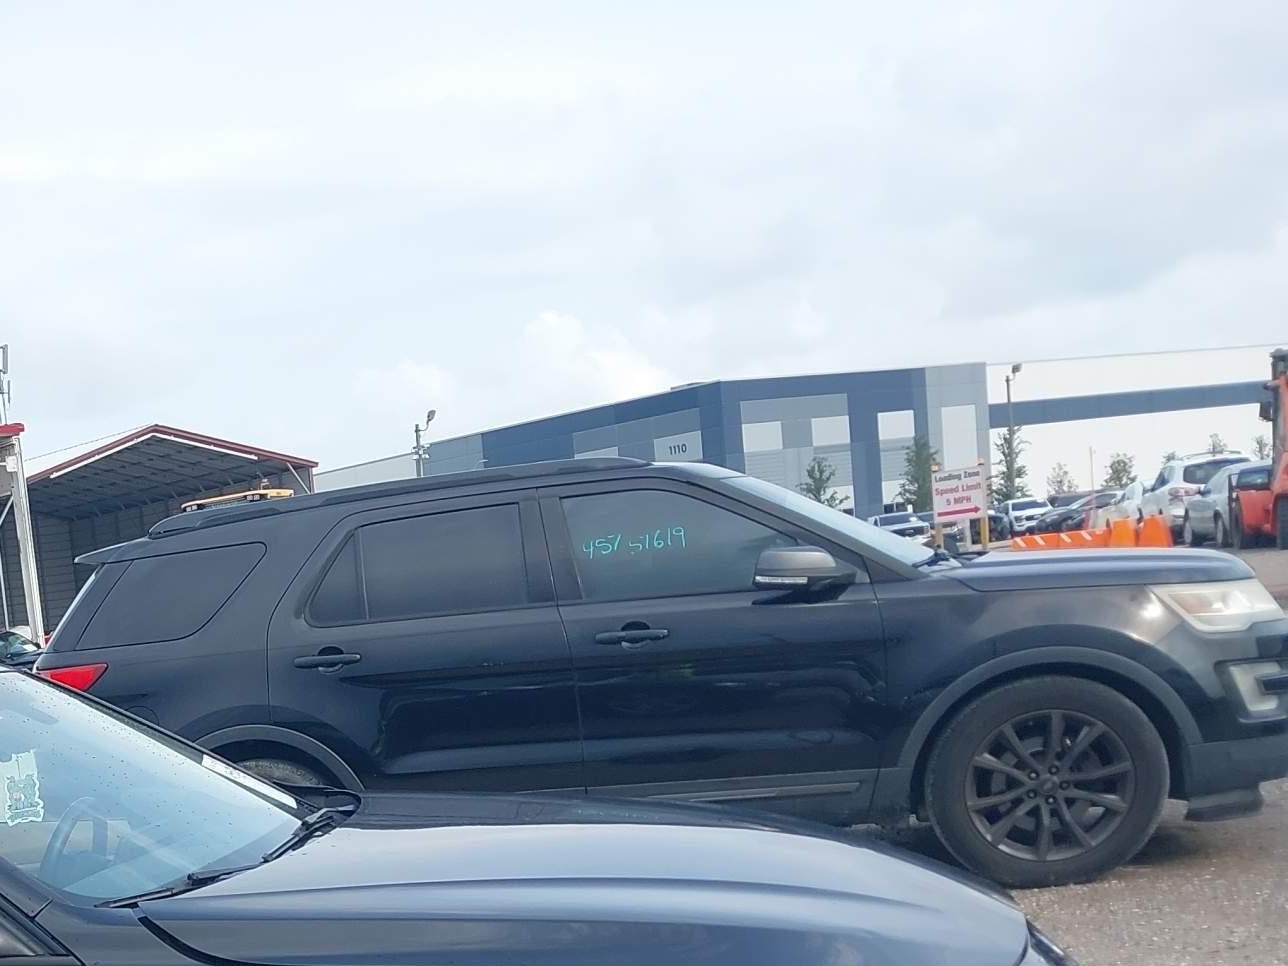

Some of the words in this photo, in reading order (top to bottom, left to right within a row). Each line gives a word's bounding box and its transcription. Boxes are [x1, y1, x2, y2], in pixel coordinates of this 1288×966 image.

[669, 443, 687, 455] 1110
[935, 473, 961, 482] Loading
[935, 485, 959, 496] Speed
[961, 482, 981, 492] Limit
[953, 496, 971, 504] MPH
